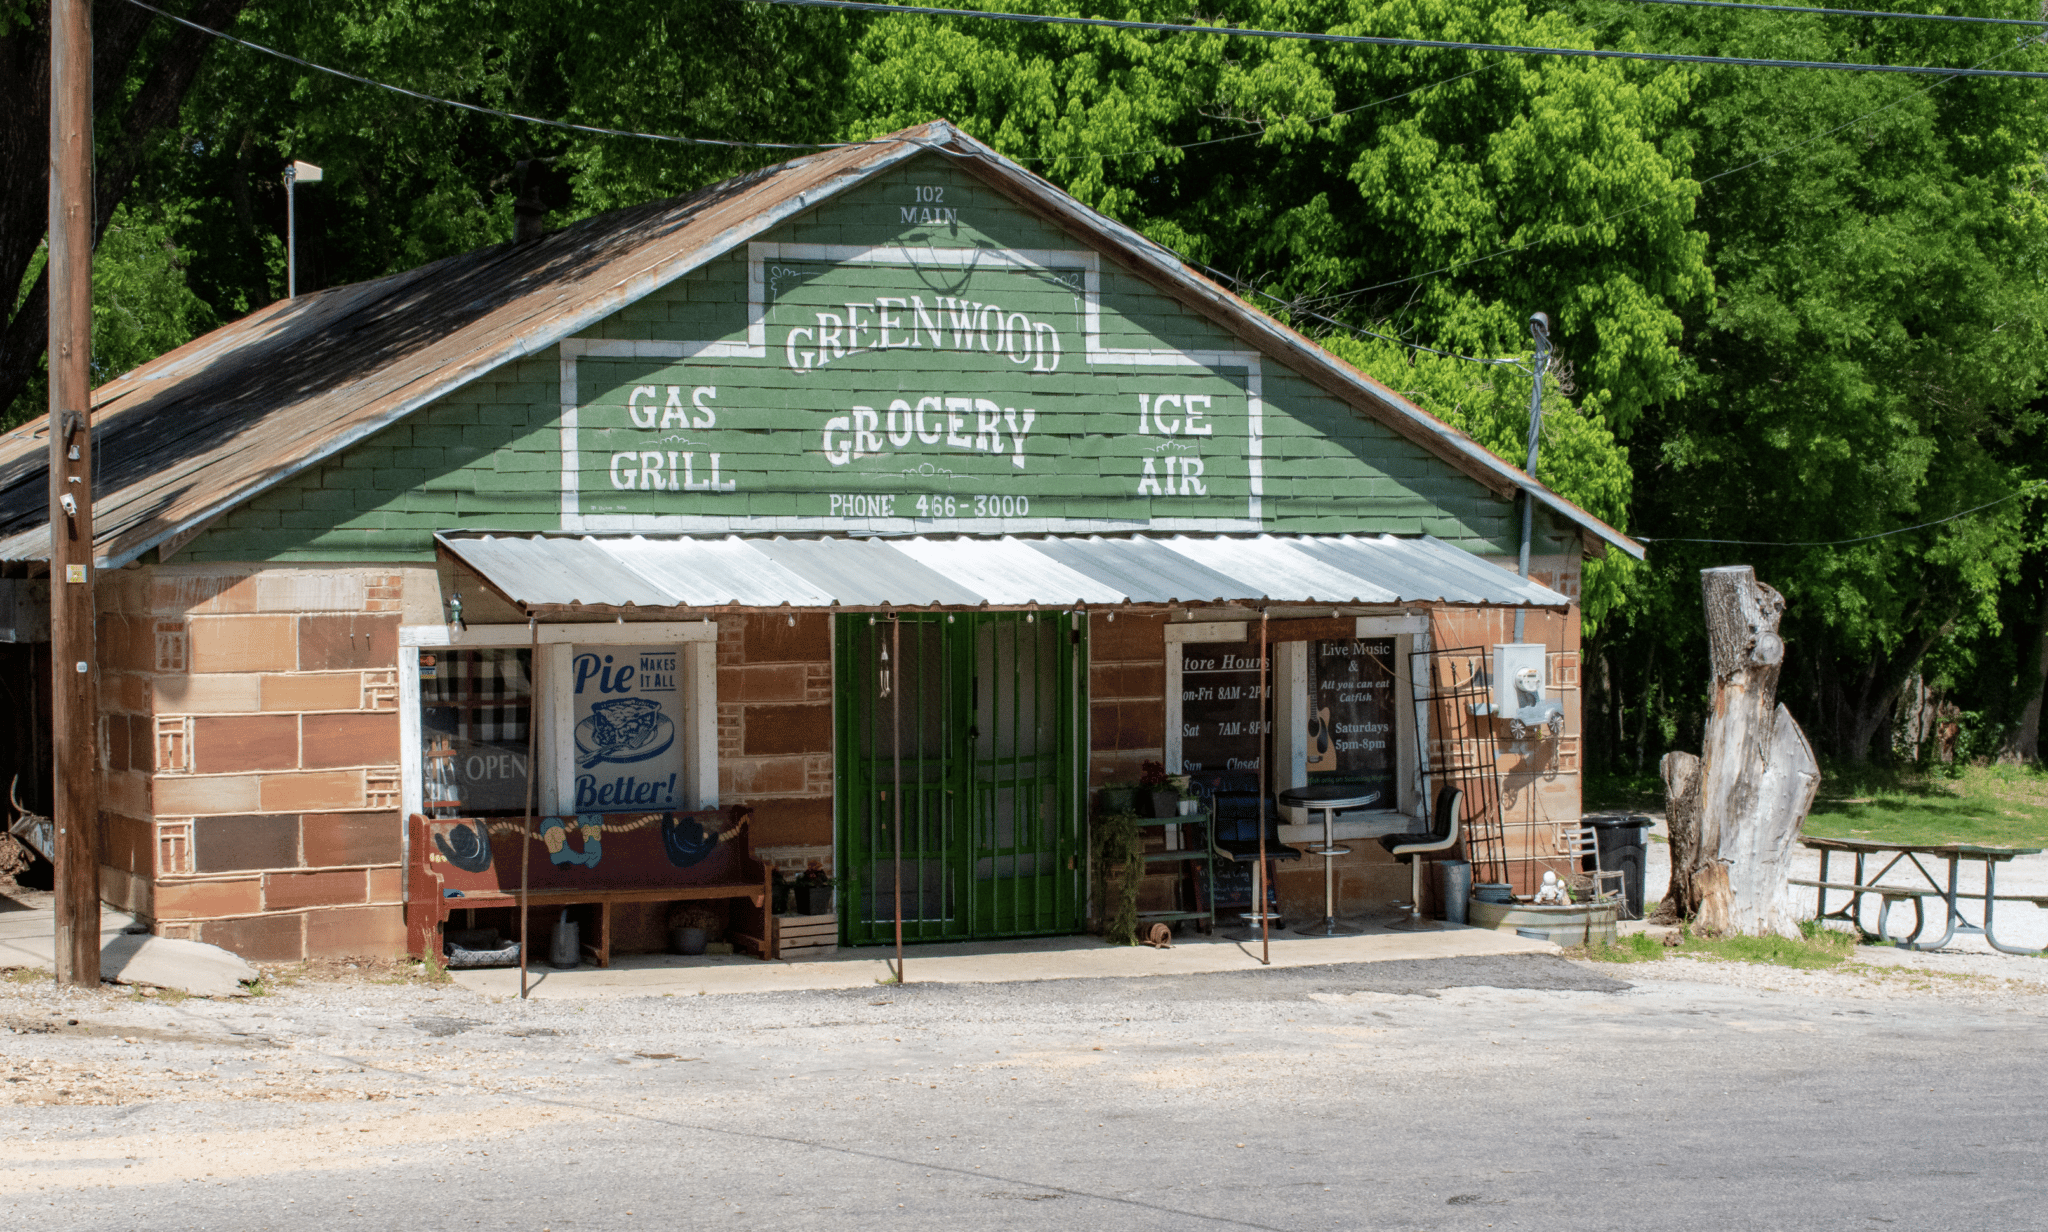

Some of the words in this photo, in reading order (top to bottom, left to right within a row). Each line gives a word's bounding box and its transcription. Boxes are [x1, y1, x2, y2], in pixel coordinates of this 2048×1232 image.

[915, 186, 944, 203] 102
[900, 206, 958, 225] MAIN
[786, 295, 1061, 374] GREENWOOD
[628, 385, 717, 429] GAS
[1138, 393, 1213, 436] ICE
[823, 396, 1036, 470] GROCERY
[609, 451, 736, 491] GRILL
[1137, 456, 1207, 496] AIR
[829, 494, 895, 517] PHONE
[915, 494, 1029, 518] 466-3000
[1322, 643, 1349, 656] Live
[1353, 642, 1391, 655] Music
[640, 657, 676, 671] MAKES
[1182, 657, 1215, 671] tore
[1348, 660, 1359, 672] &
[572, 653, 635, 694] Pie
[640, 674, 650, 687] IT
[654, 674, 675, 687] ALL
[1182, 687, 1213, 701] on-Fri
[1218, 686, 1241, 700] 8AM
[1321, 680, 1335, 690] All
[1337, 682, 1354, 692] you
[1356, 681, 1373, 689] can
[1375, 680, 1390, 689] eat
[1339, 693, 1372, 703] Catfish
[1183, 723, 1200, 737] Sat
[1218, 722, 1241, 736] 7AM
[1335, 721, 1389, 734] Saturdays
[1335, 738, 1386, 752] 5pm-8pm
[465, 755, 527, 781] OPEN
[1183, 759, 1202, 771] Sun
[1226, 757, 1260, 770] Closed
[575, 773, 676, 807] Better!
